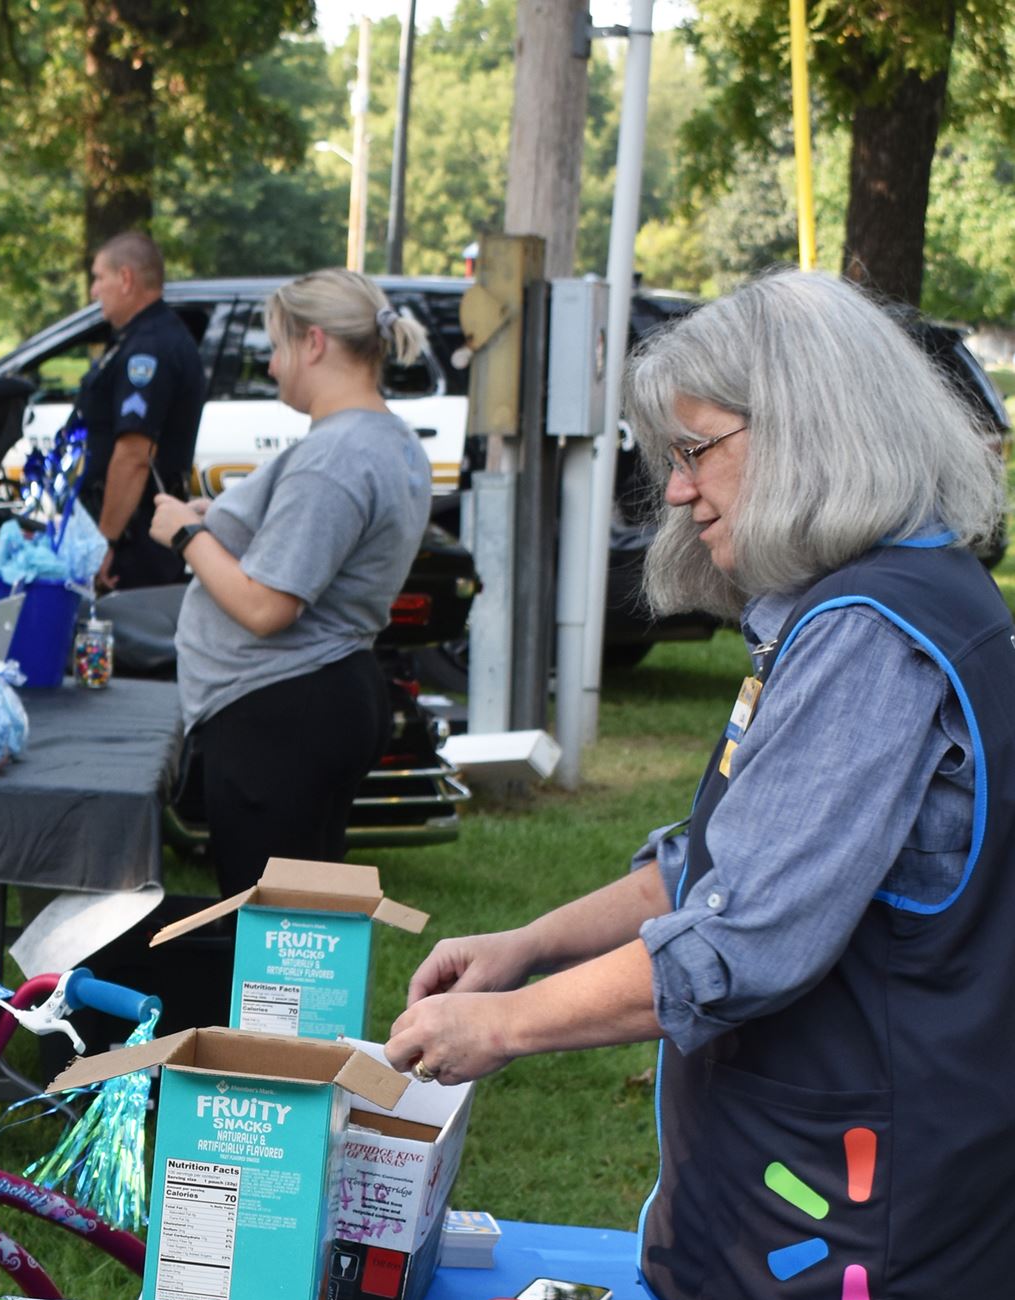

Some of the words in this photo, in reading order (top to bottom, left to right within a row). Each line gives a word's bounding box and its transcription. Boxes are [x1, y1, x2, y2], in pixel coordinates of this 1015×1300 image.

[278, 948, 325, 959] SNACKS
[244, 983, 277, 991] Nutrition
[213, 1117, 272, 1133] SNACKS
[217, 1130, 258, 1145] NATURALLY
[260, 1136, 265, 1145] &
[197, 1140, 244, 1154] ARTIFICIALLY
[246, 1145, 284, 1159] FLAVORED
[396, 1151, 424, 1163] KING
[347, 1150, 359, 1159] OF
[364, 1153, 406, 1168] KANSAS
[168, 1160, 210, 1172] Nutrition
[213, 1166, 240, 1175] Facts
[166, 1189, 198, 1199] Calories
[225, 1194, 237, 1203] 70
